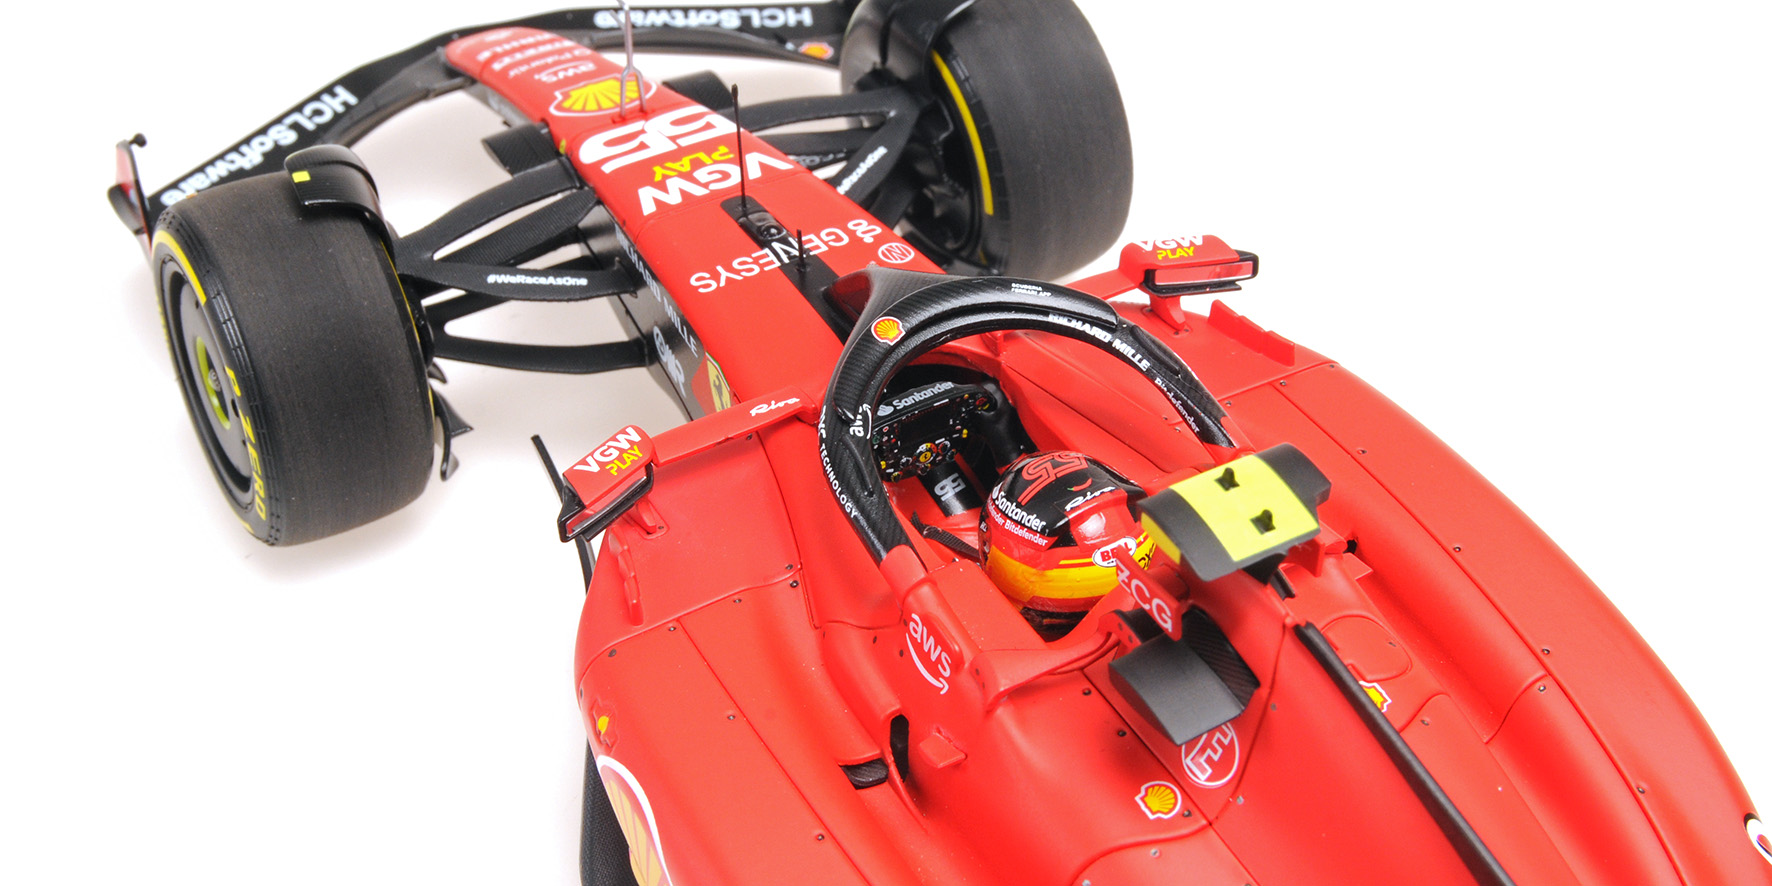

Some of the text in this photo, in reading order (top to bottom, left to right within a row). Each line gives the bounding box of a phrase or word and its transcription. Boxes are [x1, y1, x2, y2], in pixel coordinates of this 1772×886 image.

[579, 105, 742, 174] 55
[652, 145, 735, 182] PLAY
[637, 152, 795, 216] VGW
[689, 227, 850, 293] GENESYS
[1156, 246, 1195, 260] PLAY
[487, 274, 588, 286] #WeRaceAsOne
[1111, 338, 1151, 372] MILLE
[749, 397, 801, 417] Riva
[892, 381, 954, 409] Santander
[225, 365, 241, 397] P
[239, 408, 266, 520] ZERO
[573, 426, 642, 473] VGW
[605, 444, 643, 476] PLAY
[820, 443, 858, 518] TECHNOLOGY
[995, 491, 1046, 532] Santander
[1004, 520, 1048, 547] Bitdefender
[909, 613, 951, 678] aws
